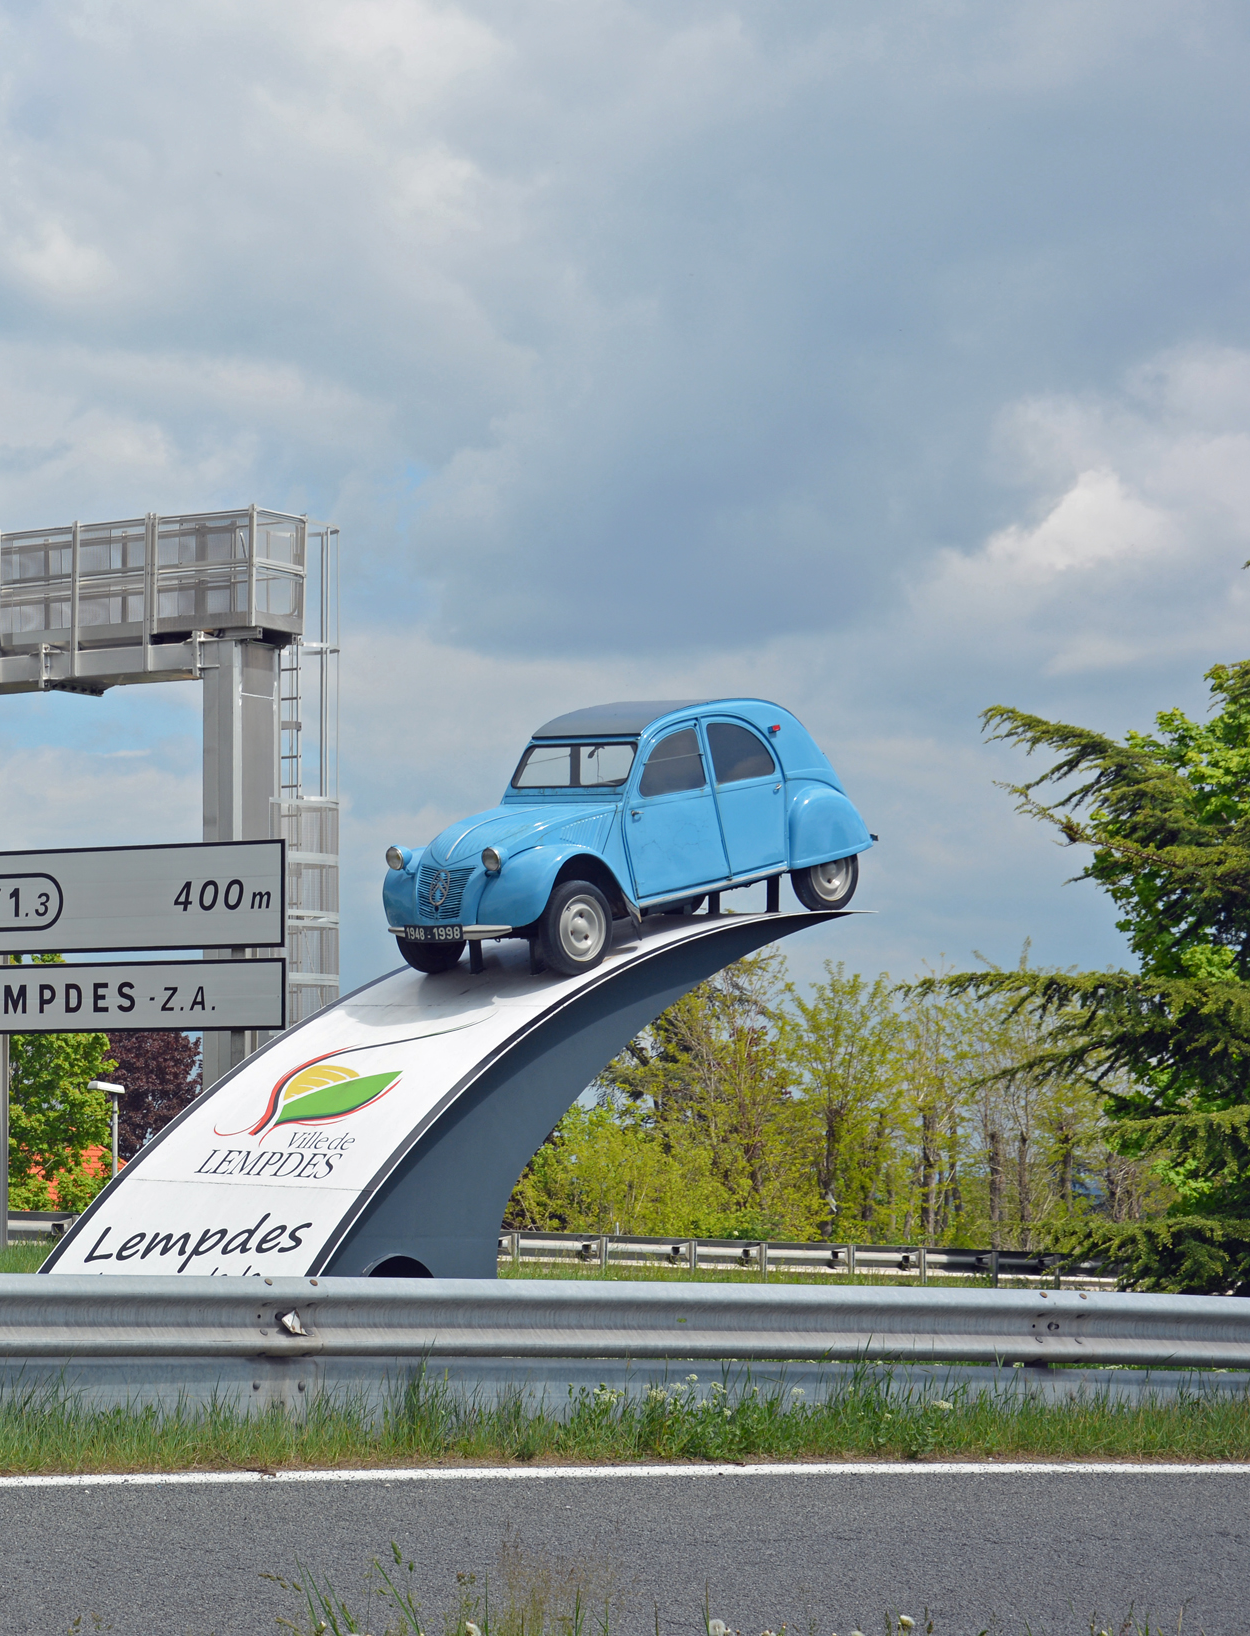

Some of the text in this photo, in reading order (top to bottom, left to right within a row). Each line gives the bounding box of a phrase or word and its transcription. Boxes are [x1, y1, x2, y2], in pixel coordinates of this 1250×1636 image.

[9, 888, 50, 918] 1.3
[174, 879, 272, 912] 400 m
[406, 927, 425, 940] 1948
[432, 926, 461, 940] 1998
[287, 1131, 356, 1151] Ville de
[193, 1149, 343, 1179] LEMPDES
[83, 1212, 313, 1273] Lempdes
